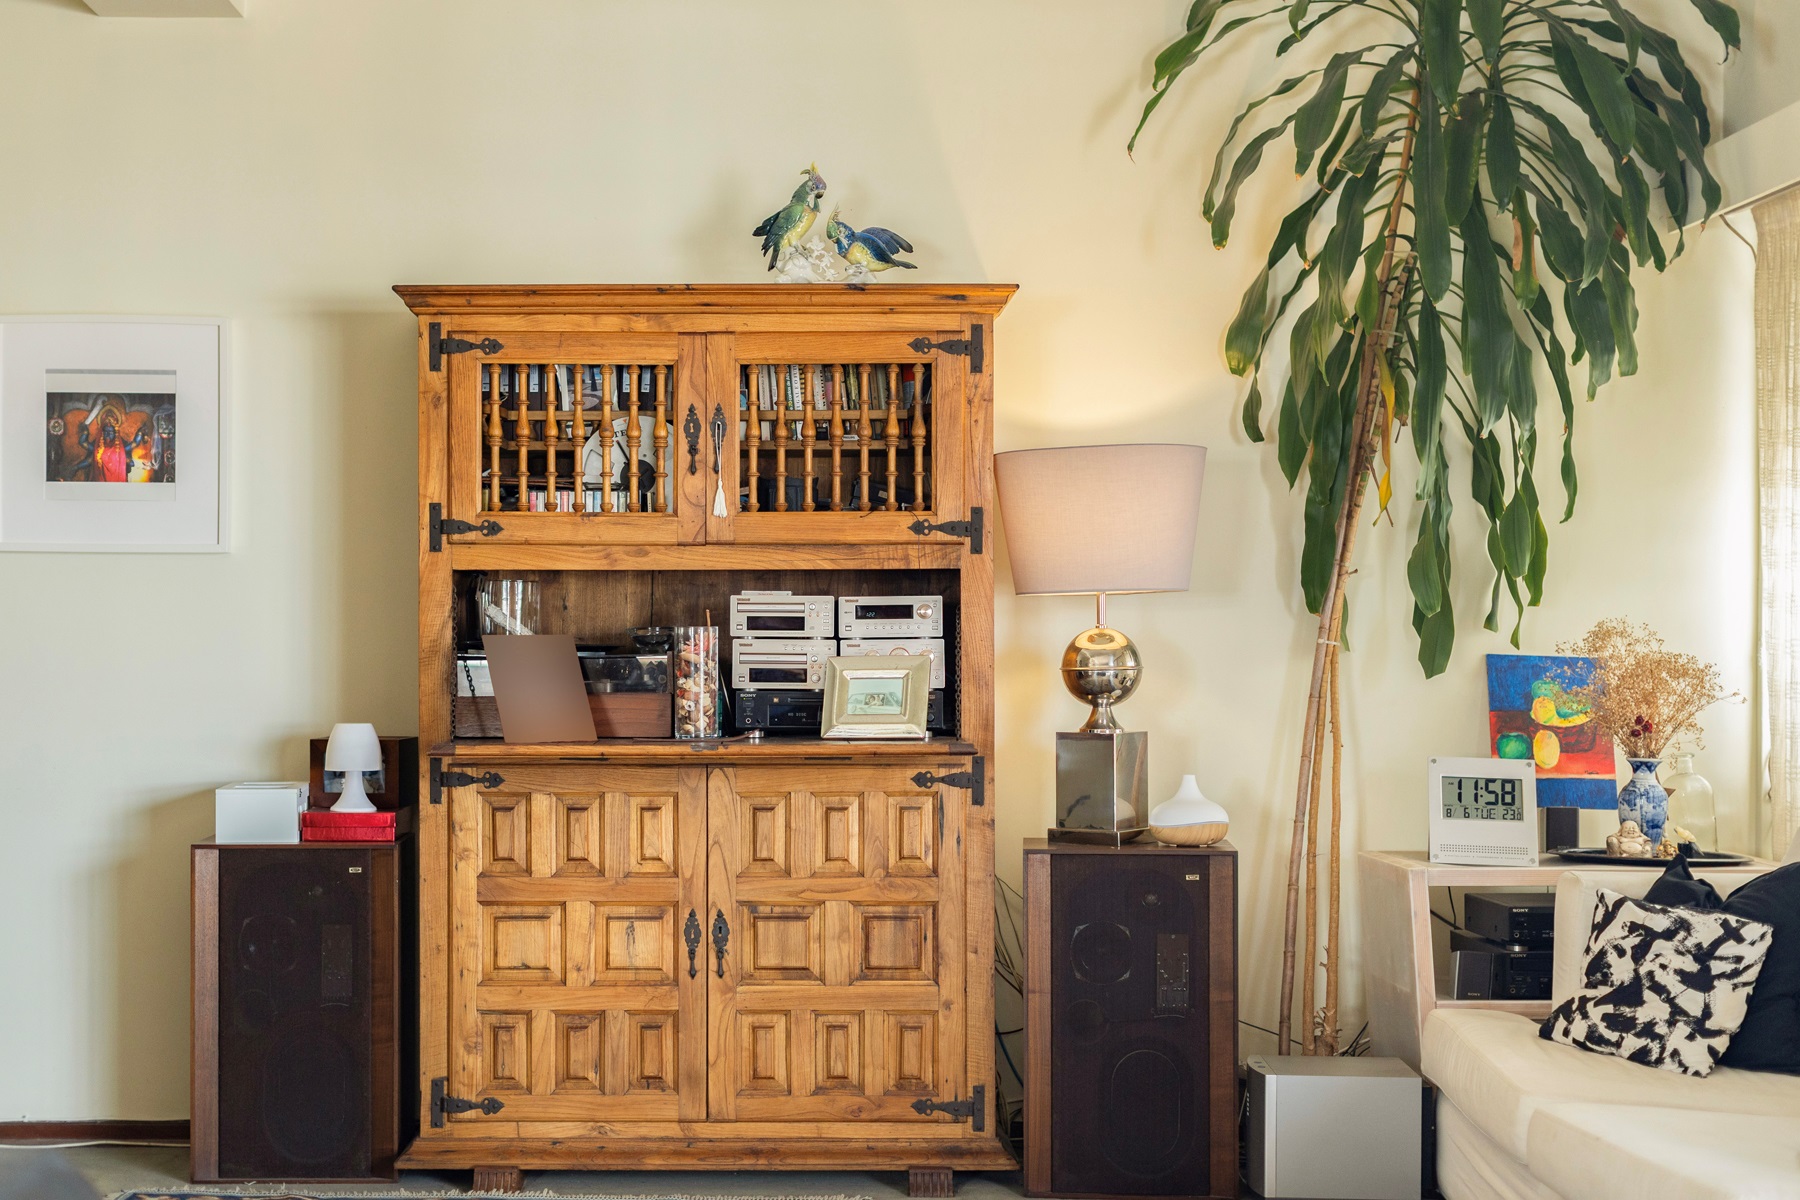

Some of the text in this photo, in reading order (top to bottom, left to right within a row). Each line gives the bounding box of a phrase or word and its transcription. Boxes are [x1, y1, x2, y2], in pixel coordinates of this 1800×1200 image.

[1457, 778, 1516, 806] 11:58
[1463, 807, 1470, 818] 6
[1474, 807, 1496, 819] TUE
